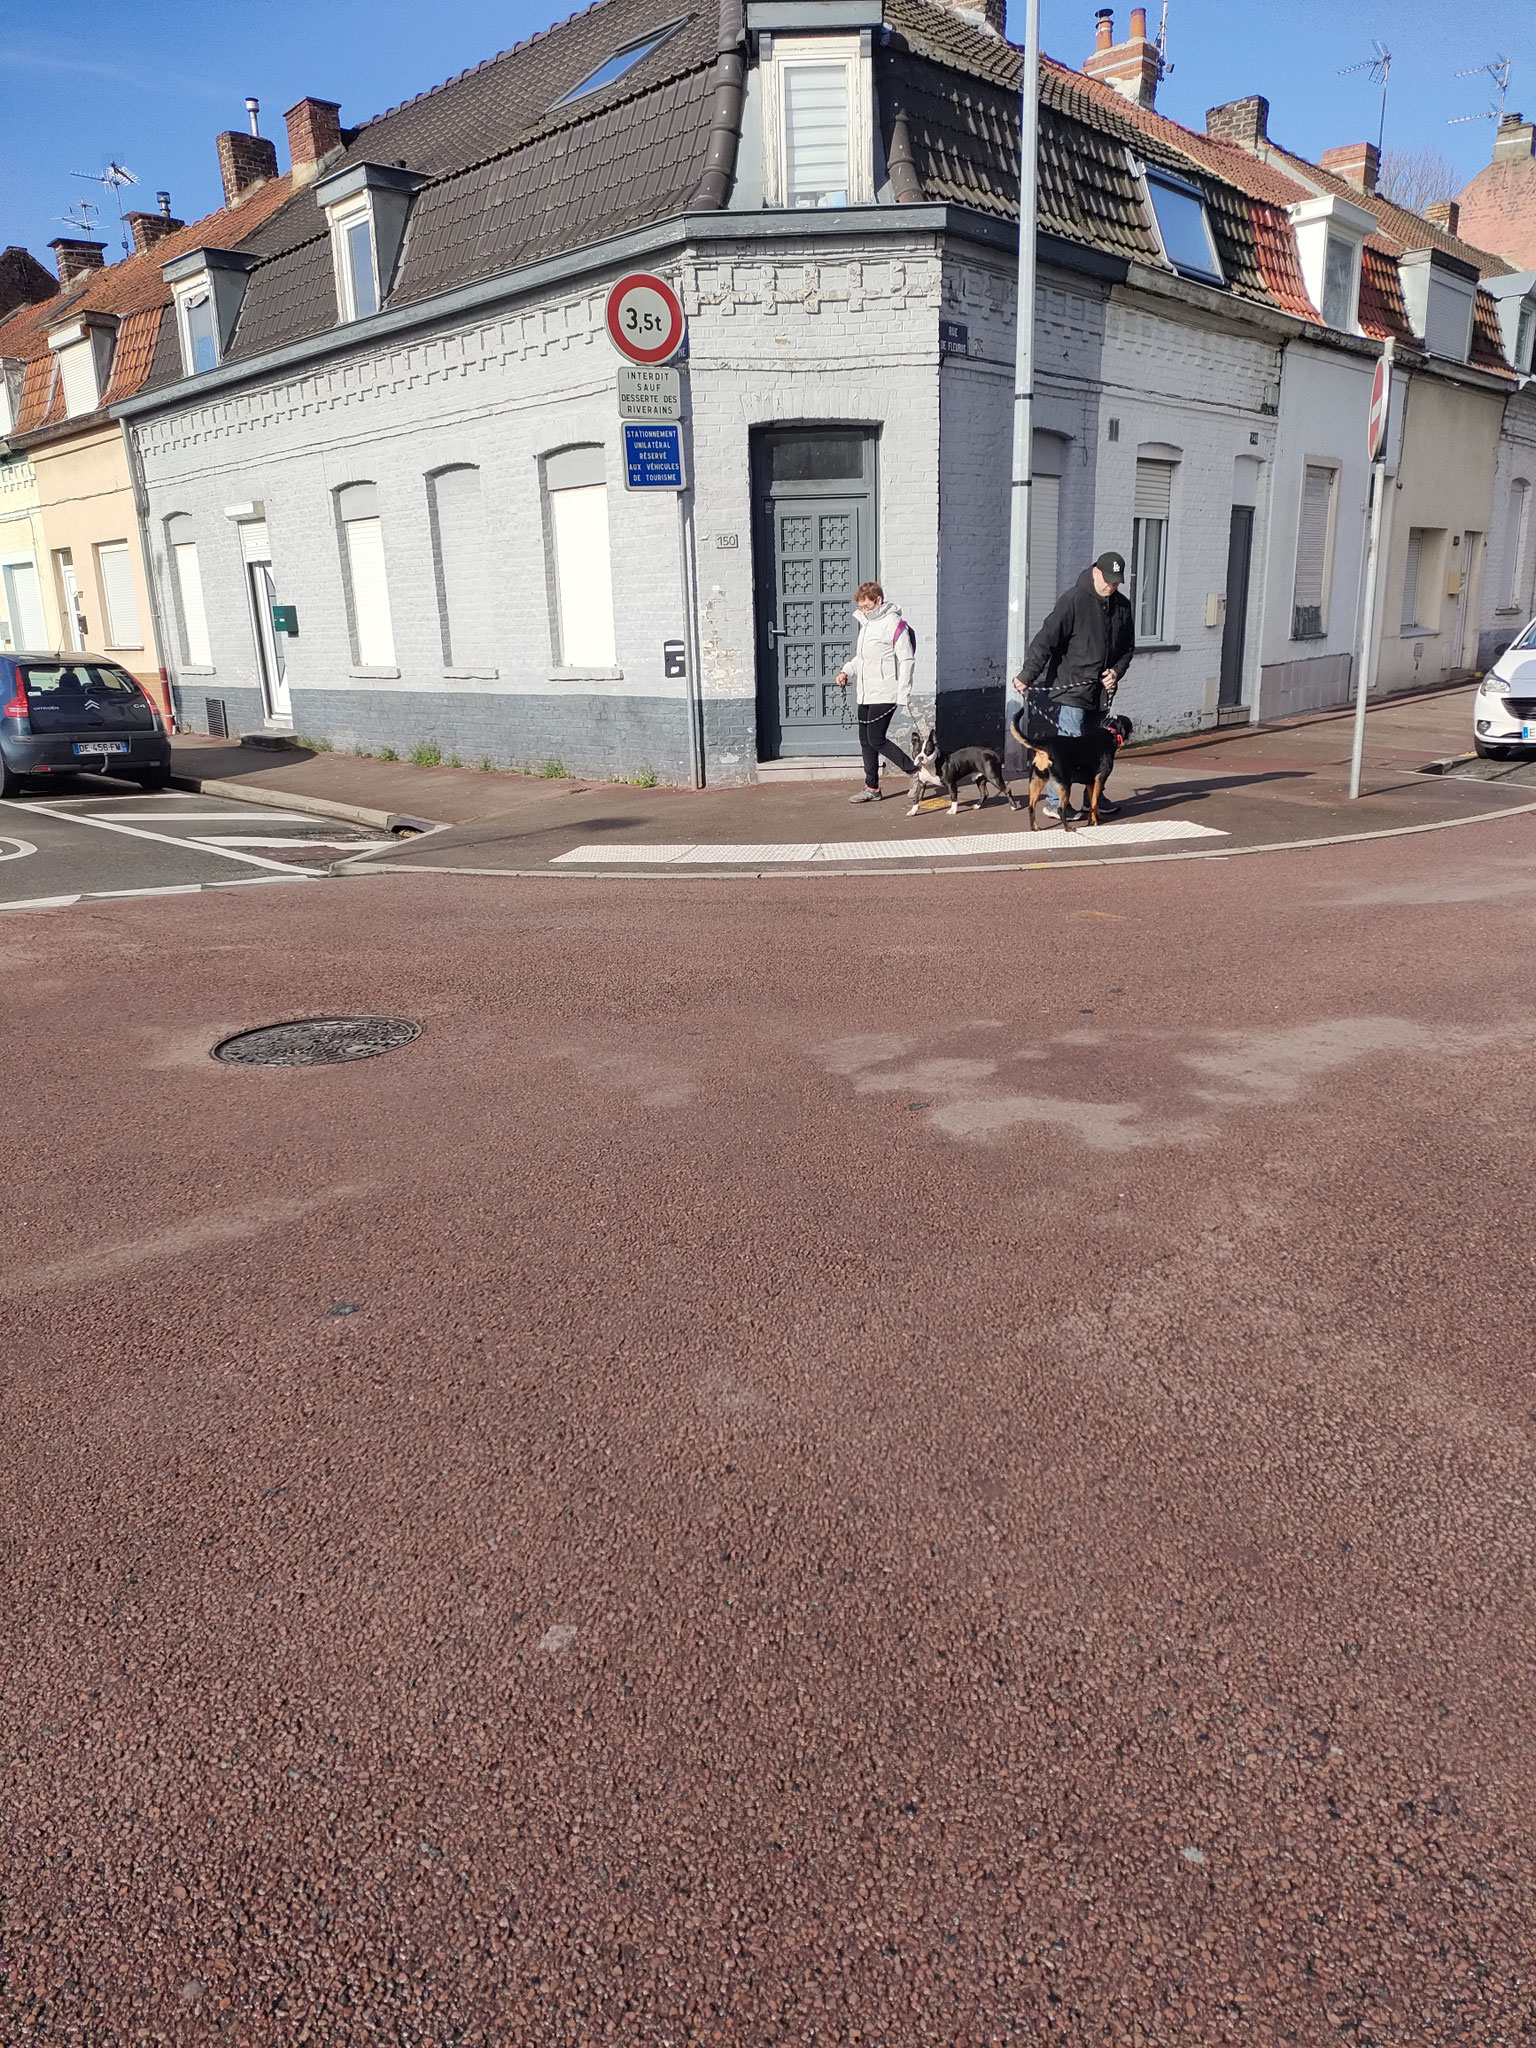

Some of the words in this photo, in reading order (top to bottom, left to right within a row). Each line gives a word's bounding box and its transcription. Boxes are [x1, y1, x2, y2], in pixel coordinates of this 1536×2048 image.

[626, 307, 662, 334] 3,5t
[948, 326, 958, 337] RUE
[940, 339, 947, 351] DE
[627, 371, 669, 381] INTERDIT
[637, 383, 661, 392] SAUF
[621, 394, 659, 403] DESSERTE
[663, 395, 678, 404] DES
[627, 405, 673, 414] RIVERAINS
[626, 430, 676, 438] STATIONNEMENT
[633, 440, 671, 449] UNILATÉRAL
[639, 451, 667, 460] RÉSERVÉ
[629, 463, 642, 471] AUX
[646, 462, 680, 471] VÉHICULES
[633, 474, 641, 482] DE
[646, 473, 677, 482] TOURISME
[717, 535, 736, 546] 150
